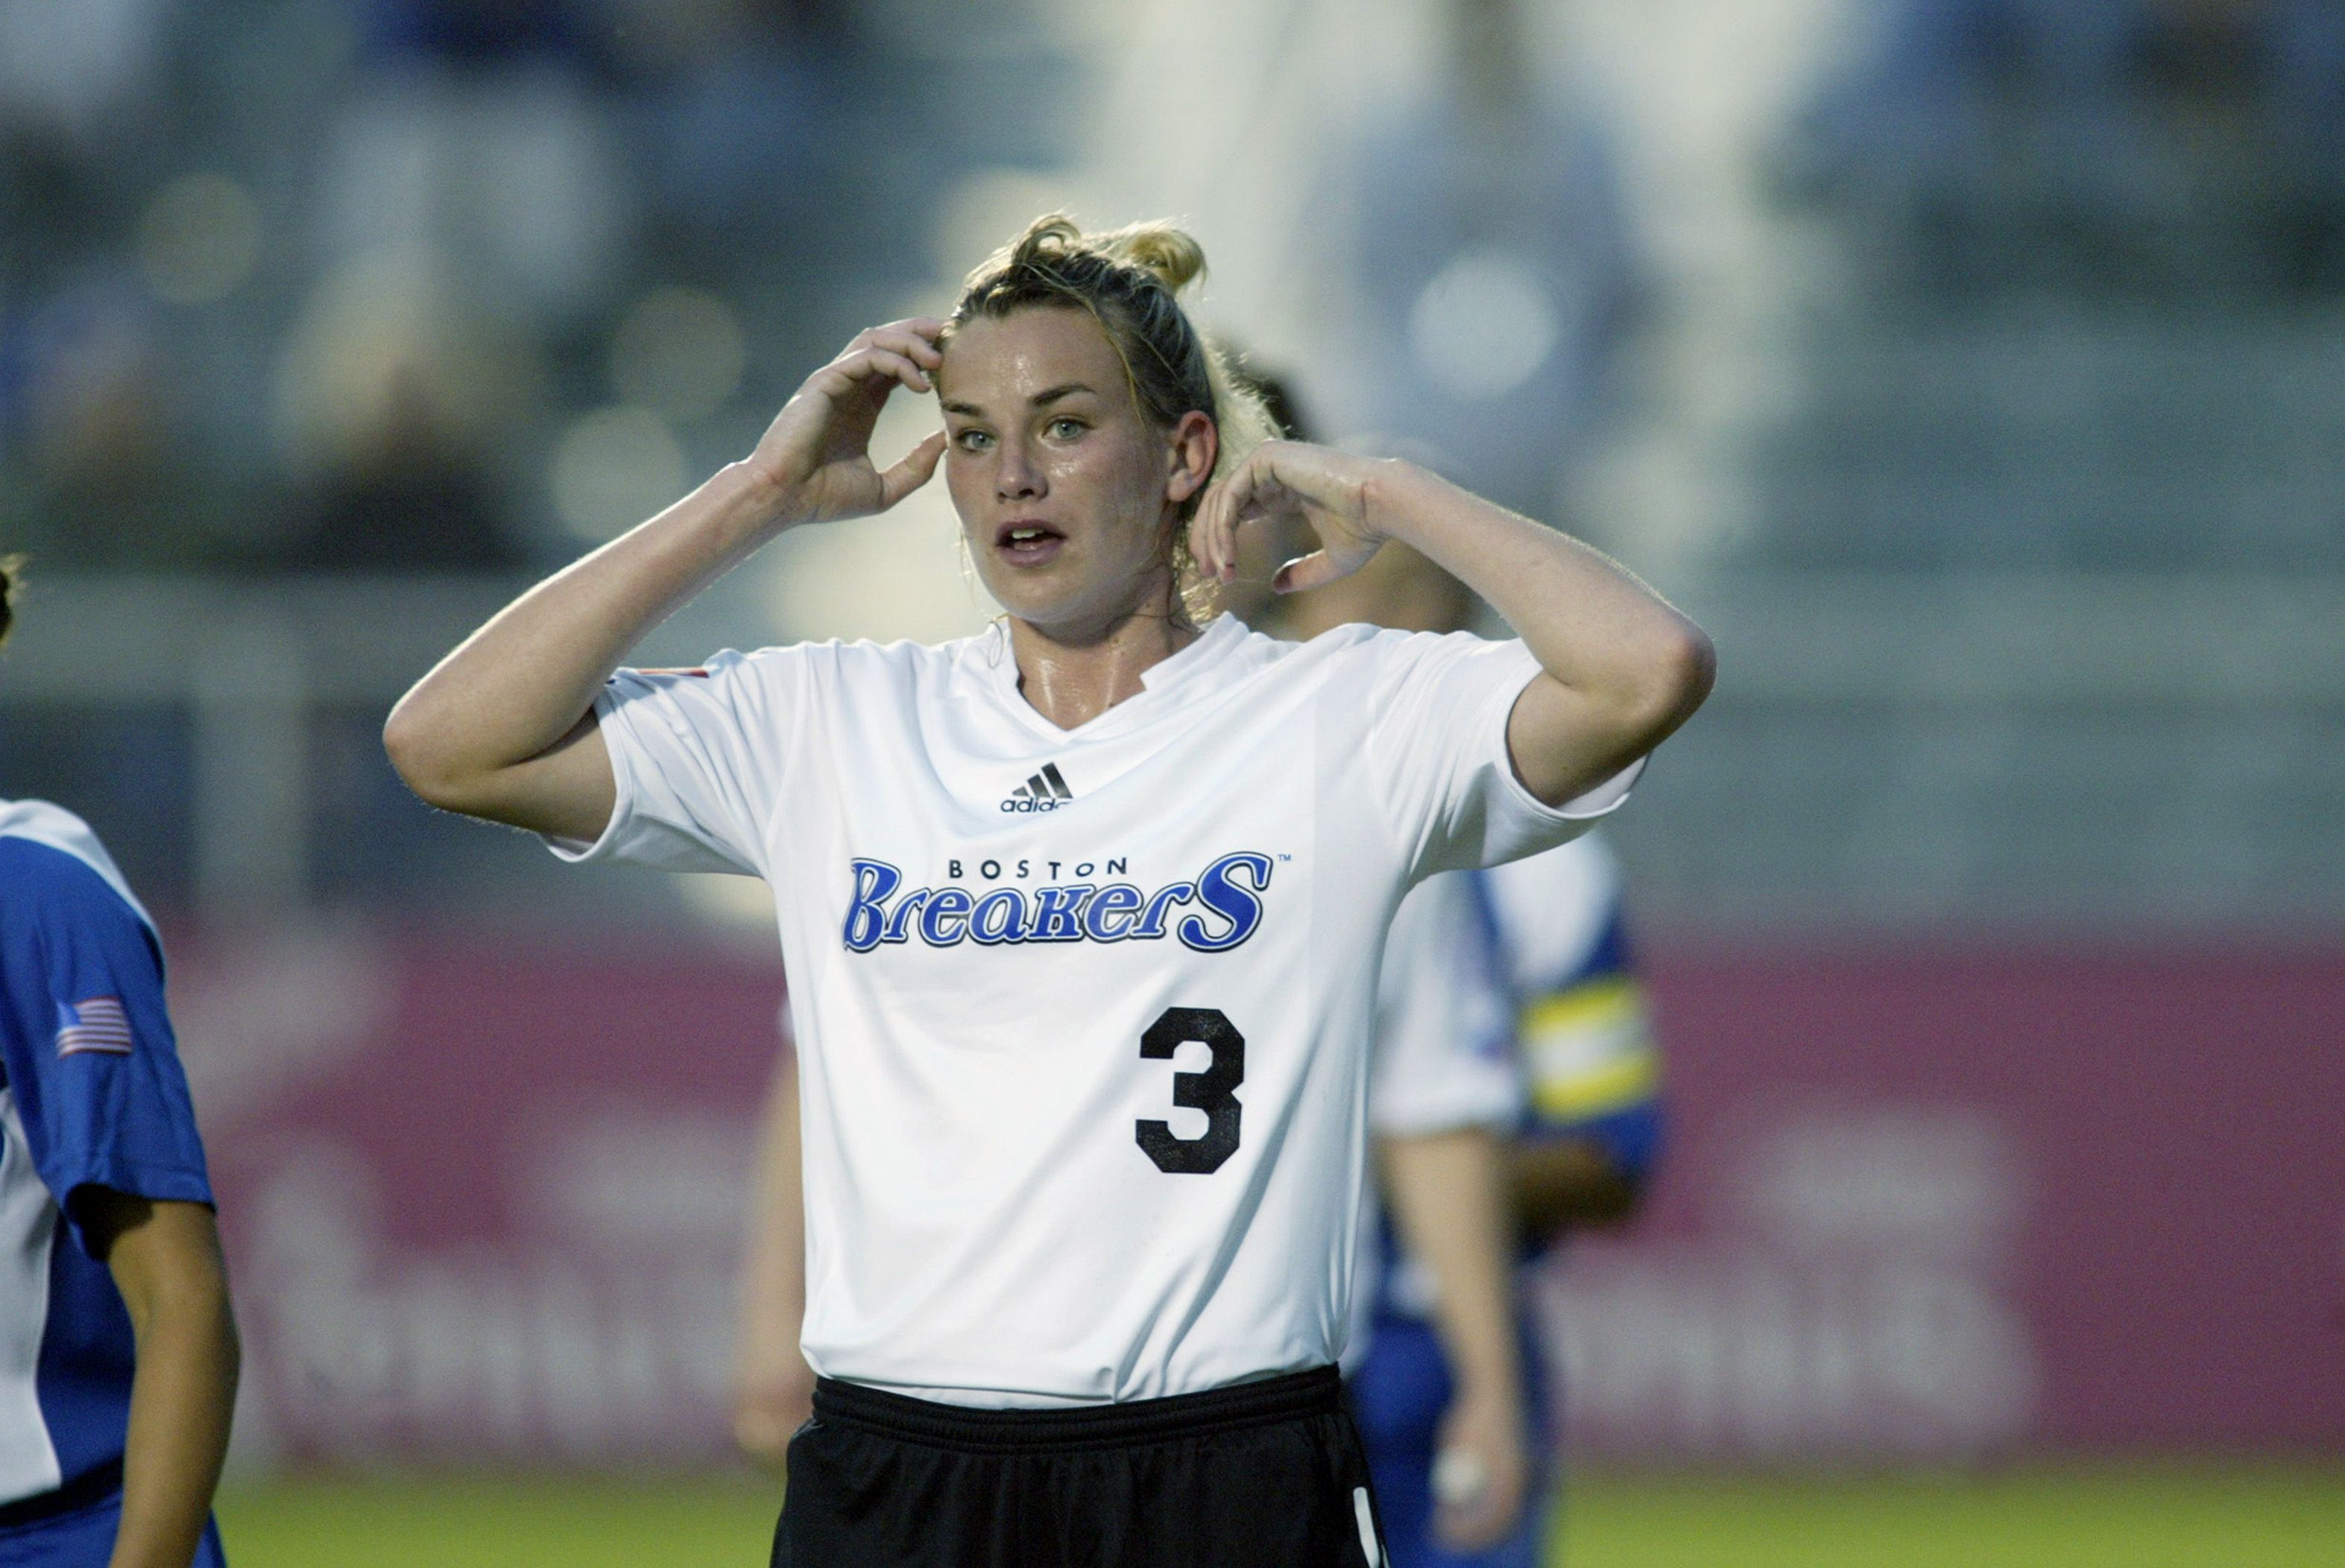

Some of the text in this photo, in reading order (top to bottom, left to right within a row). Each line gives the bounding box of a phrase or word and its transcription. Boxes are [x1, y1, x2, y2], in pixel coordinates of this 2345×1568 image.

[1000, 797, 1071, 812] adid
[949, 857, 1127, 880] BOSTON
[1135, 1006, 1246, 1175] 3
